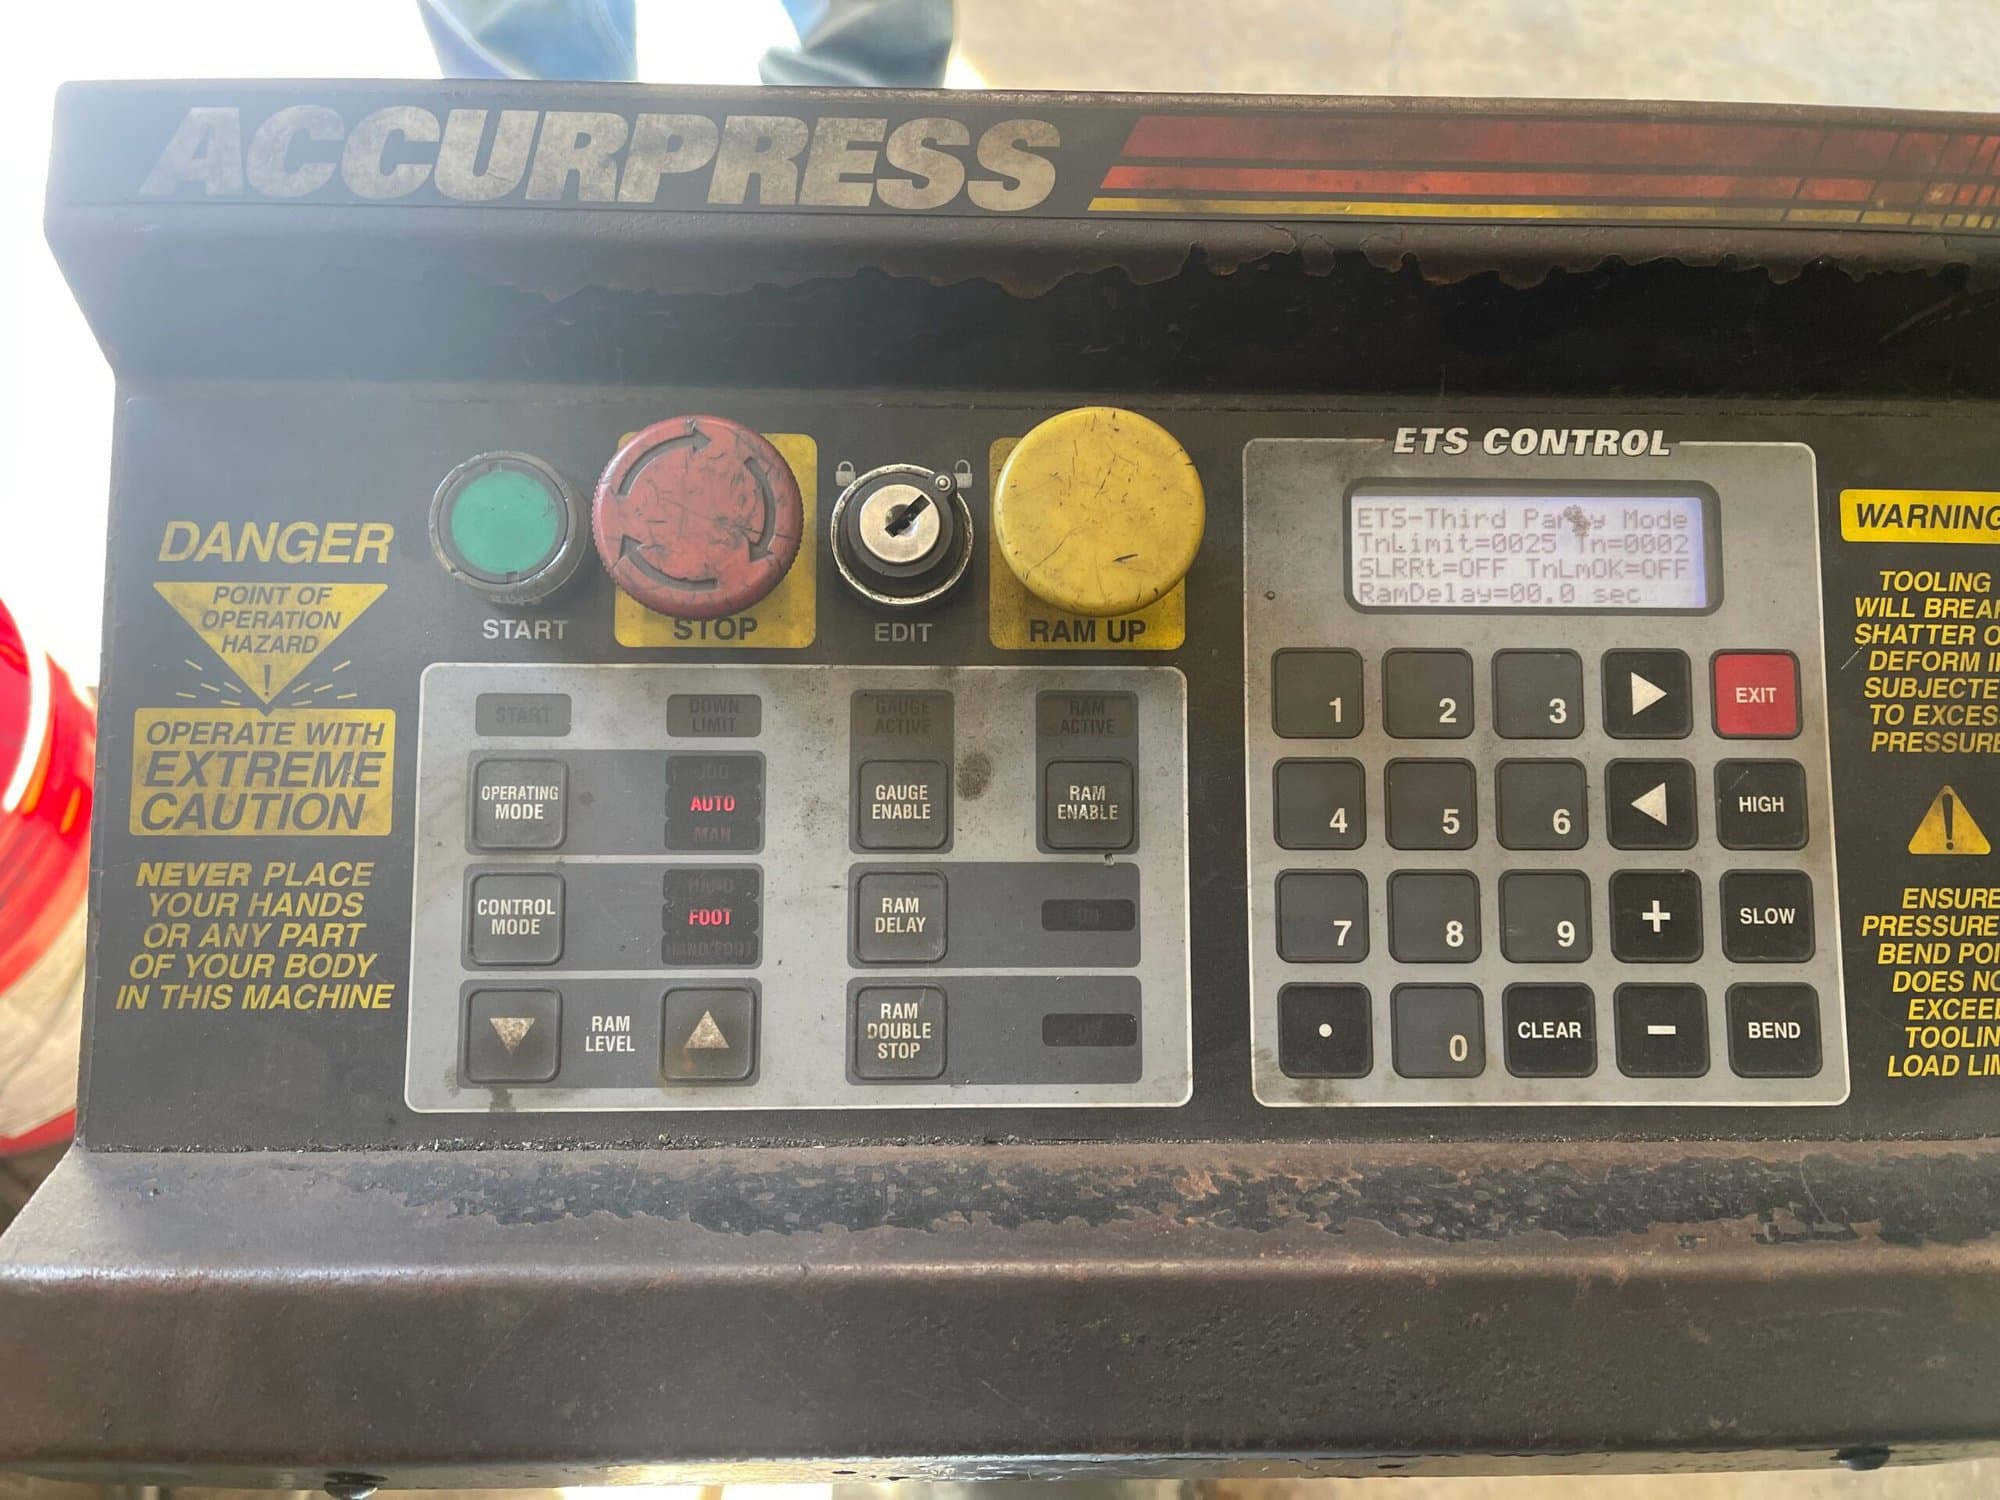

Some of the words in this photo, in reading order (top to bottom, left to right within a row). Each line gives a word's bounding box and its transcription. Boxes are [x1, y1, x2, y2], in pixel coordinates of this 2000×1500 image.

[137, 105, 1062, 211] ACCURPRESS
[1393, 427, 1469, 455] ETS
[1482, 428, 1672, 456] CONTROL
[1357, 507, 1507, 529] ETS-Third
[1523, 507, 1605, 529] Pary
[1622, 508, 1689, 529] Mode
[1856, 503, 2000, 531] WARNING
[158, 520, 394, 564] DANGER
[1359, 533, 1557, 554] TnLimit=0025
[1880, 570, 1991, 593] TOOLING
[213, 586, 290, 605] POINT
[297, 586, 332, 605] OF
[1359, 583, 1576, 604] RamDelay=00.0
[1593, 587, 1641, 604] sec
[1855, 597, 1915, 618] WILL
[202, 610, 341, 629] OPERATION
[482, 619, 568, 640] START
[673, 617, 759, 641] STOP
[874, 622, 932, 643] EDIT
[1030, 619, 1096, 643] RAM
[1107, 619, 1147, 643] UP
[1854, 623, 1976, 646] SHATTER
[221, 634, 319, 654] HAZARD
[1869, 651, 1980, 673] DEFORM
[1735, 687, 1776, 703] EXIT
[495, 707, 552, 724] START
[690, 699, 738, 714] DOWN
[875, 699, 929, 715] GAUGE
[1069, 699, 1105, 715] RAM
[1329, 697, 1342, 722] 1
[1439, 698, 1457, 723] 2
[1549, 698, 1567, 724] 3
[1869, 704, 1905, 726] TO
[1912, 704, 2000, 727] EXCES
[147, 721, 295, 745] OPERATE
[306, 722, 385, 746] WITH
[692, 717, 736, 733] LIMIT
[875, 718, 931, 735] ACTIVE
[1060, 718, 1116, 735] ACTIVE
[143, 750, 386, 788] EXTREME
[481, 785, 559, 801] OPERATING
[875, 784, 928, 801] GAUGE
[1069, 785, 1106, 801] RAM
[141, 792, 365, 831] CAUTION
[495, 804, 544, 820] MODE
[689, 795, 735, 812] AUTO
[872, 804, 931, 820] ENABLE
[1057, 804, 1118, 820] ENABLE
[1738, 796, 1784, 813] HIGH
[1329, 807, 1348, 834] 4
[1442, 808, 1460, 834] 5
[1552, 808, 1571, 835] 6
[136, 862, 252, 887] NEVER
[262, 862, 374, 887] PLACE
[149, 892, 239, 917] YOUR
[248, 892, 364, 917] HANDS
[477, 899, 556, 916] CONTROL
[882, 897, 919, 914] RAM
[1902, 887, 2000, 910] ENSURE
[491, 918, 541, 936] MODE
[688, 908, 731, 926] FOOT
[875, 917, 926, 934] DELAY
[1740, 908, 1796, 925] SLOW
[1861, 914, 2000, 938] PRESSURE
[143, 922, 192, 949] OR
[197, 922, 272, 949] ANY
[278, 922, 367, 948] PART
[1333, 920, 1352, 947] 7
[1446, 920, 1464, 947] 8
[1557, 920, 1576, 947] 9
[1877, 942, 1951, 965] BEND
[129, 953, 176, 979] OF
[186, 953, 275, 979] YOUR
[284, 953, 378, 979] BODY
[1892, 970, 1965, 993] DOES
[115, 984, 150, 1010] IN
[160, 984, 233, 1010] THIS
[241, 984, 395, 1010] MACHINE
[880, 1002, 918, 1019] RAM
[591, 1015, 630, 1033] RAM
[867, 1022, 931, 1040] DOUBLE
[1518, 1022, 1582, 1039] CLEAR
[1748, 1022, 1801, 1039] BEND
[585, 1035, 635, 1053] LEVEL
[877, 1042, 921, 1060] STOP
[1449, 1034, 1468, 1062] 0
[1887, 1054, 1960, 1078] LOAD
